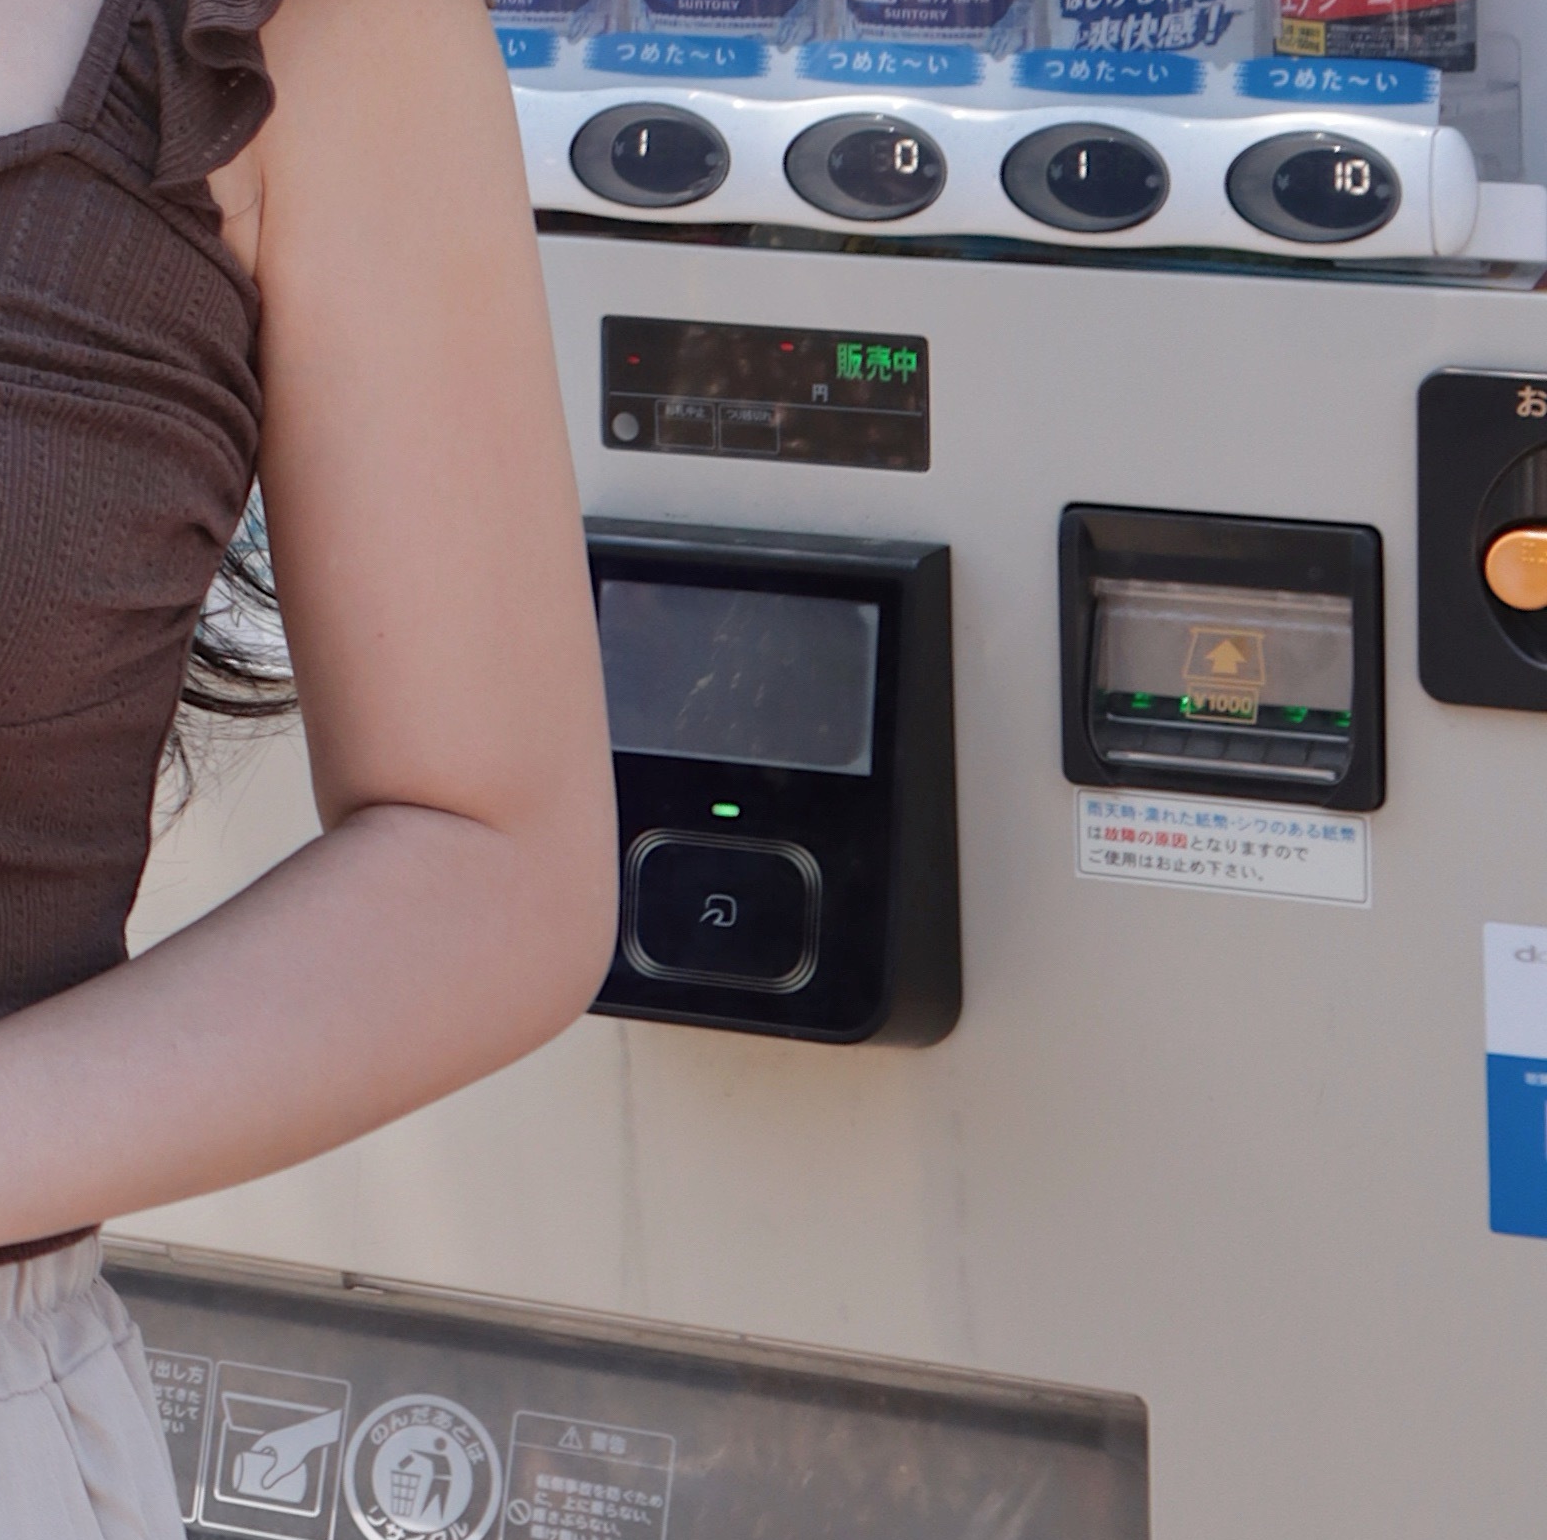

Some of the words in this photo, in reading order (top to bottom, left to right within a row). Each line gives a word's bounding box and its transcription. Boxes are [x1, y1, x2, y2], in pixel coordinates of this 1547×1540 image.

[836, 343, 918, 383] 販売中
[370, 1406, 486, 1465] のんだあとは
